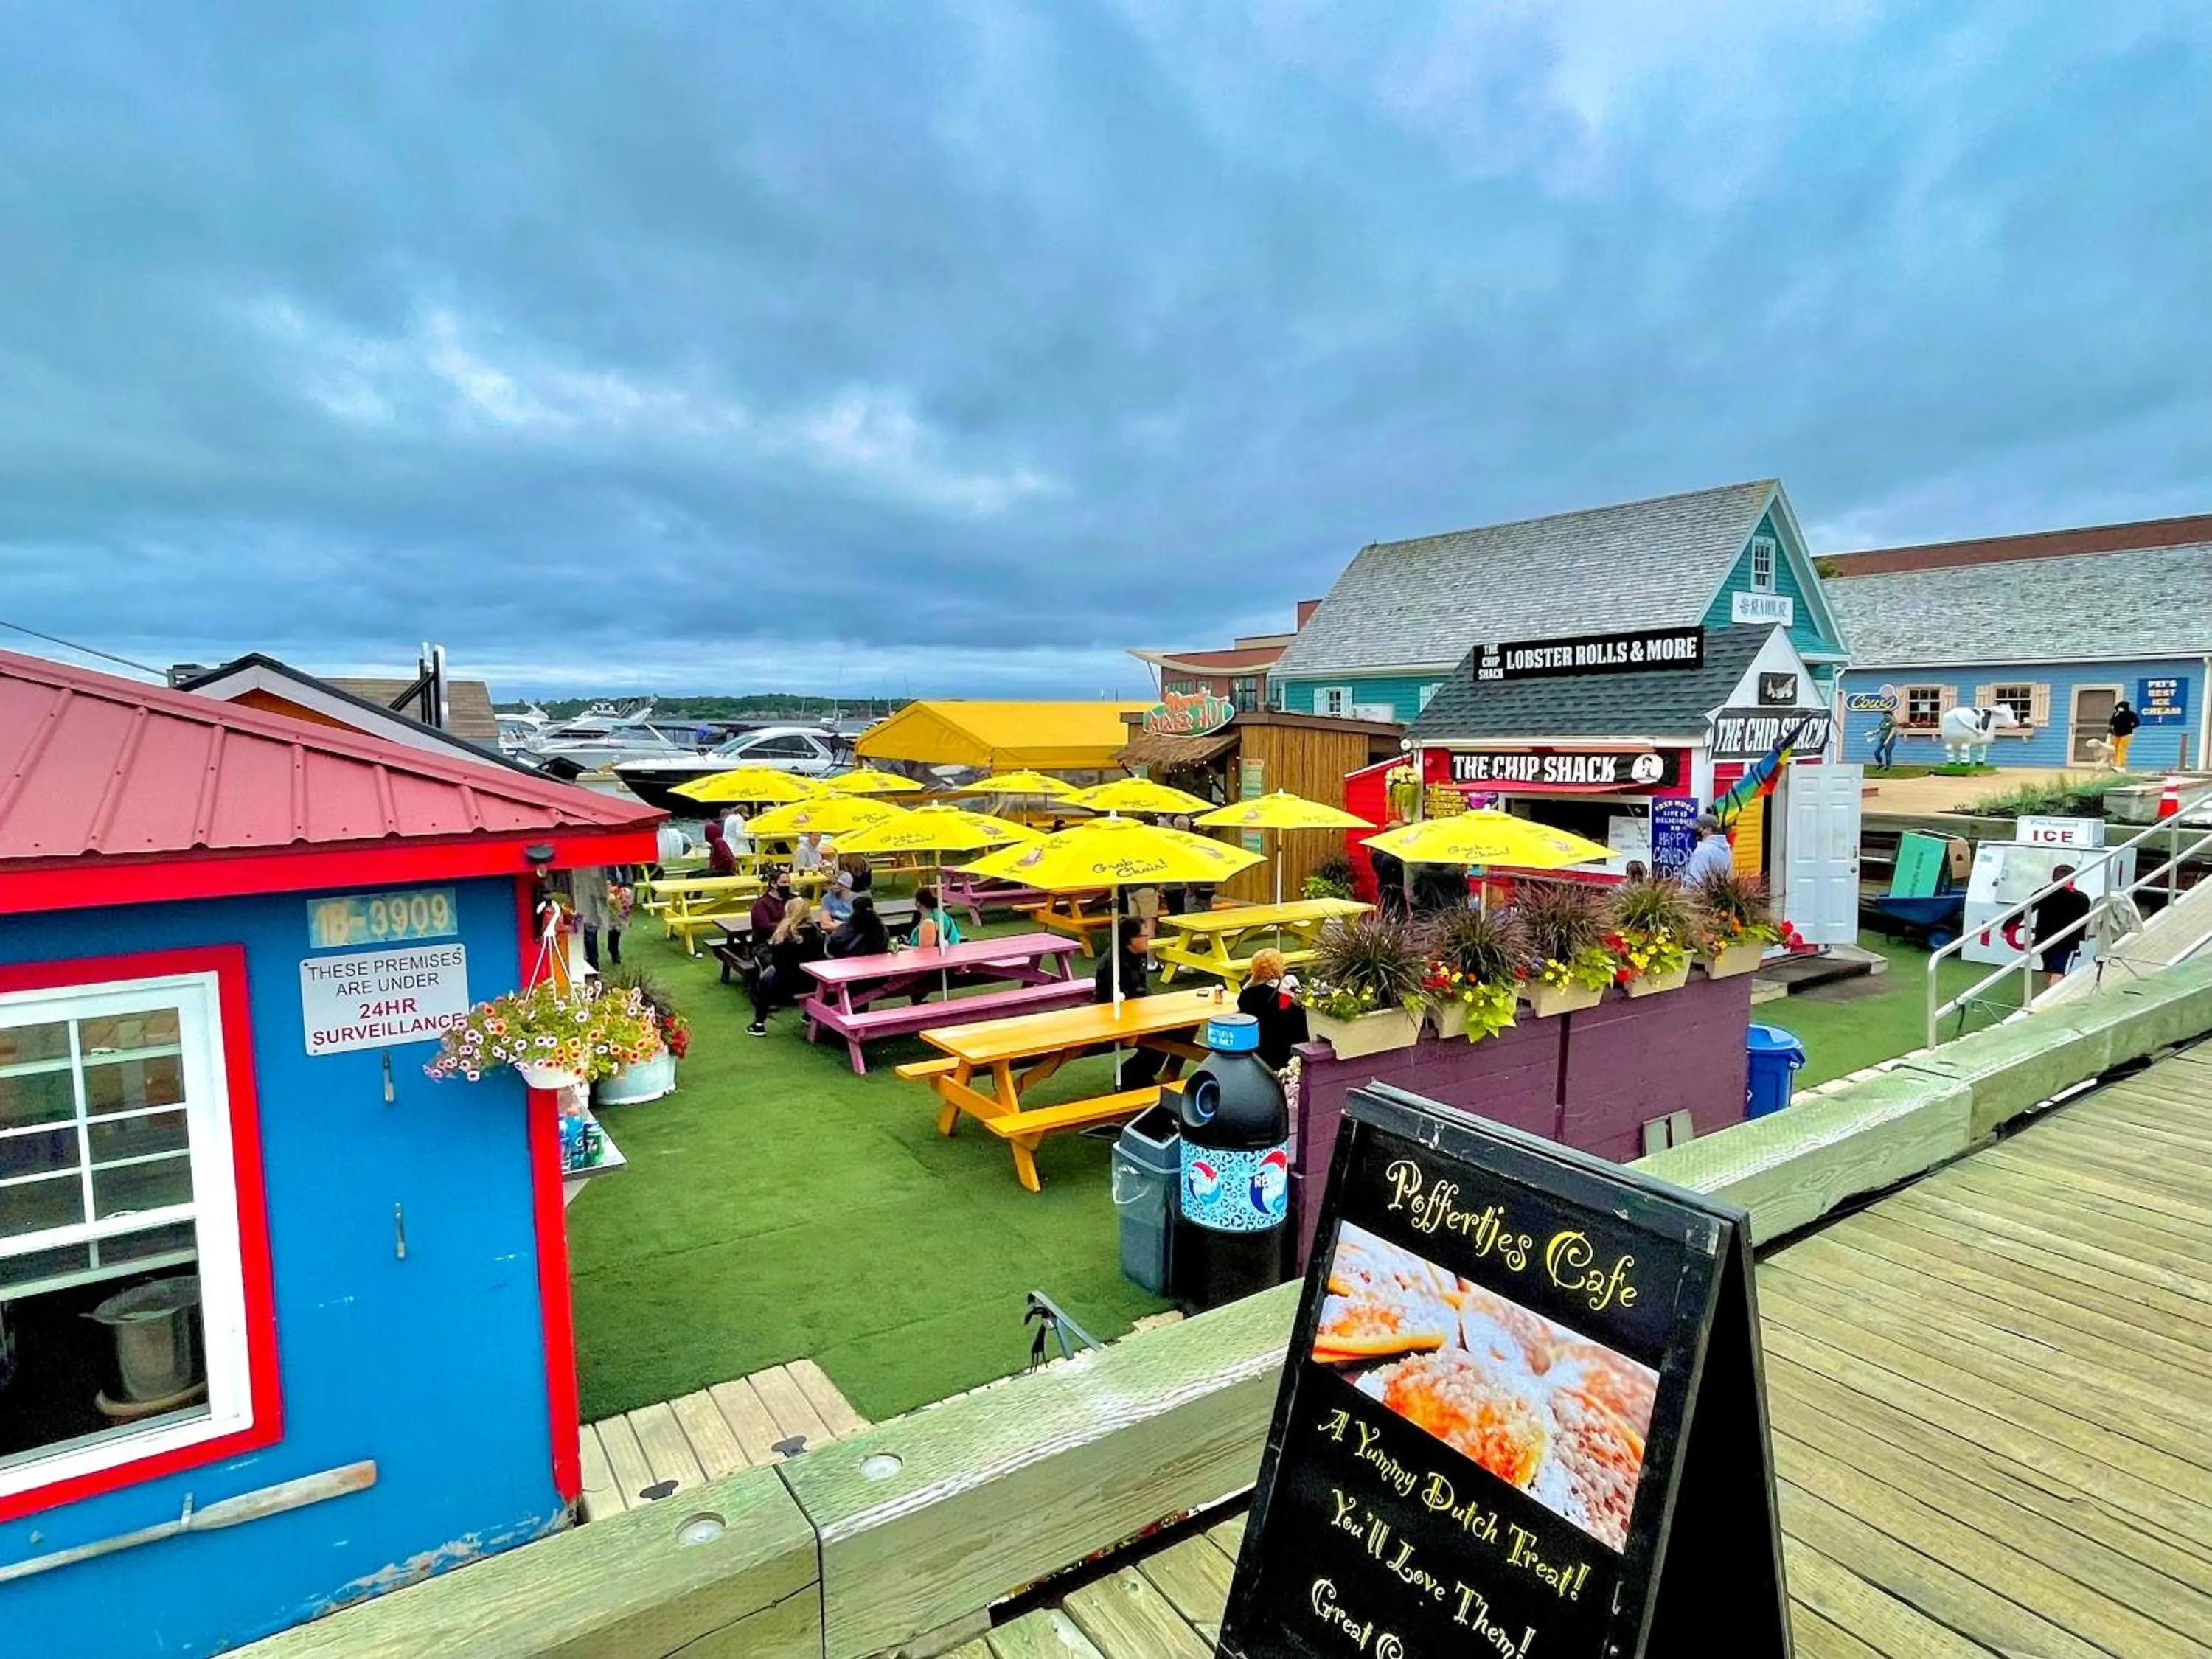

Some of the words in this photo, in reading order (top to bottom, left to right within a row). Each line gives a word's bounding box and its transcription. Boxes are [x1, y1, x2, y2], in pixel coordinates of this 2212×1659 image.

[1481, 655, 1500, 667] CHIP
[1484, 644, 1498, 655] THE
[1506, 646, 1573, 670] LOBSTER
[1576, 642, 1628, 666] ROLLS
[1630, 641, 1644, 662] &
[1646, 636, 1697, 661] MORE
[1478, 667, 1503, 680] SHACK
[1714, 718, 1745, 751] THE
[1745, 717, 1779, 751] CHIP
[1453, 755, 1489, 779] THE
[1492, 756, 1540, 782] CHIP
[1543, 755, 1618, 782] SHACK
[2033, 830, 2074, 842] ICE
[308, 961, 369, 981] THESE
[373, 951, 462, 974] PREMISES
[336, 980, 372, 997] ARE
[378, 973, 439, 992] UNDER
[359, 998, 418, 1020] 24HR
[313, 1013, 463, 1046] SURVEILLANCE
[1385, 1160, 1533, 1272] Poffertjes
[1546, 1231, 1638, 1311] Cafe
[1318, 1409, 1350, 1442] A
[1354, 1420, 1418, 1498] Yummy
[1421, 1471, 1498, 1543] Dutch
[1506, 1522, 1593, 1601] Treat!
[1330, 1489, 1391, 1559] You'll
[1385, 1538, 1446, 1601] Love
[1453, 1580, 1537, 1659] Them!
[1312, 1578, 1374, 1651] Great
